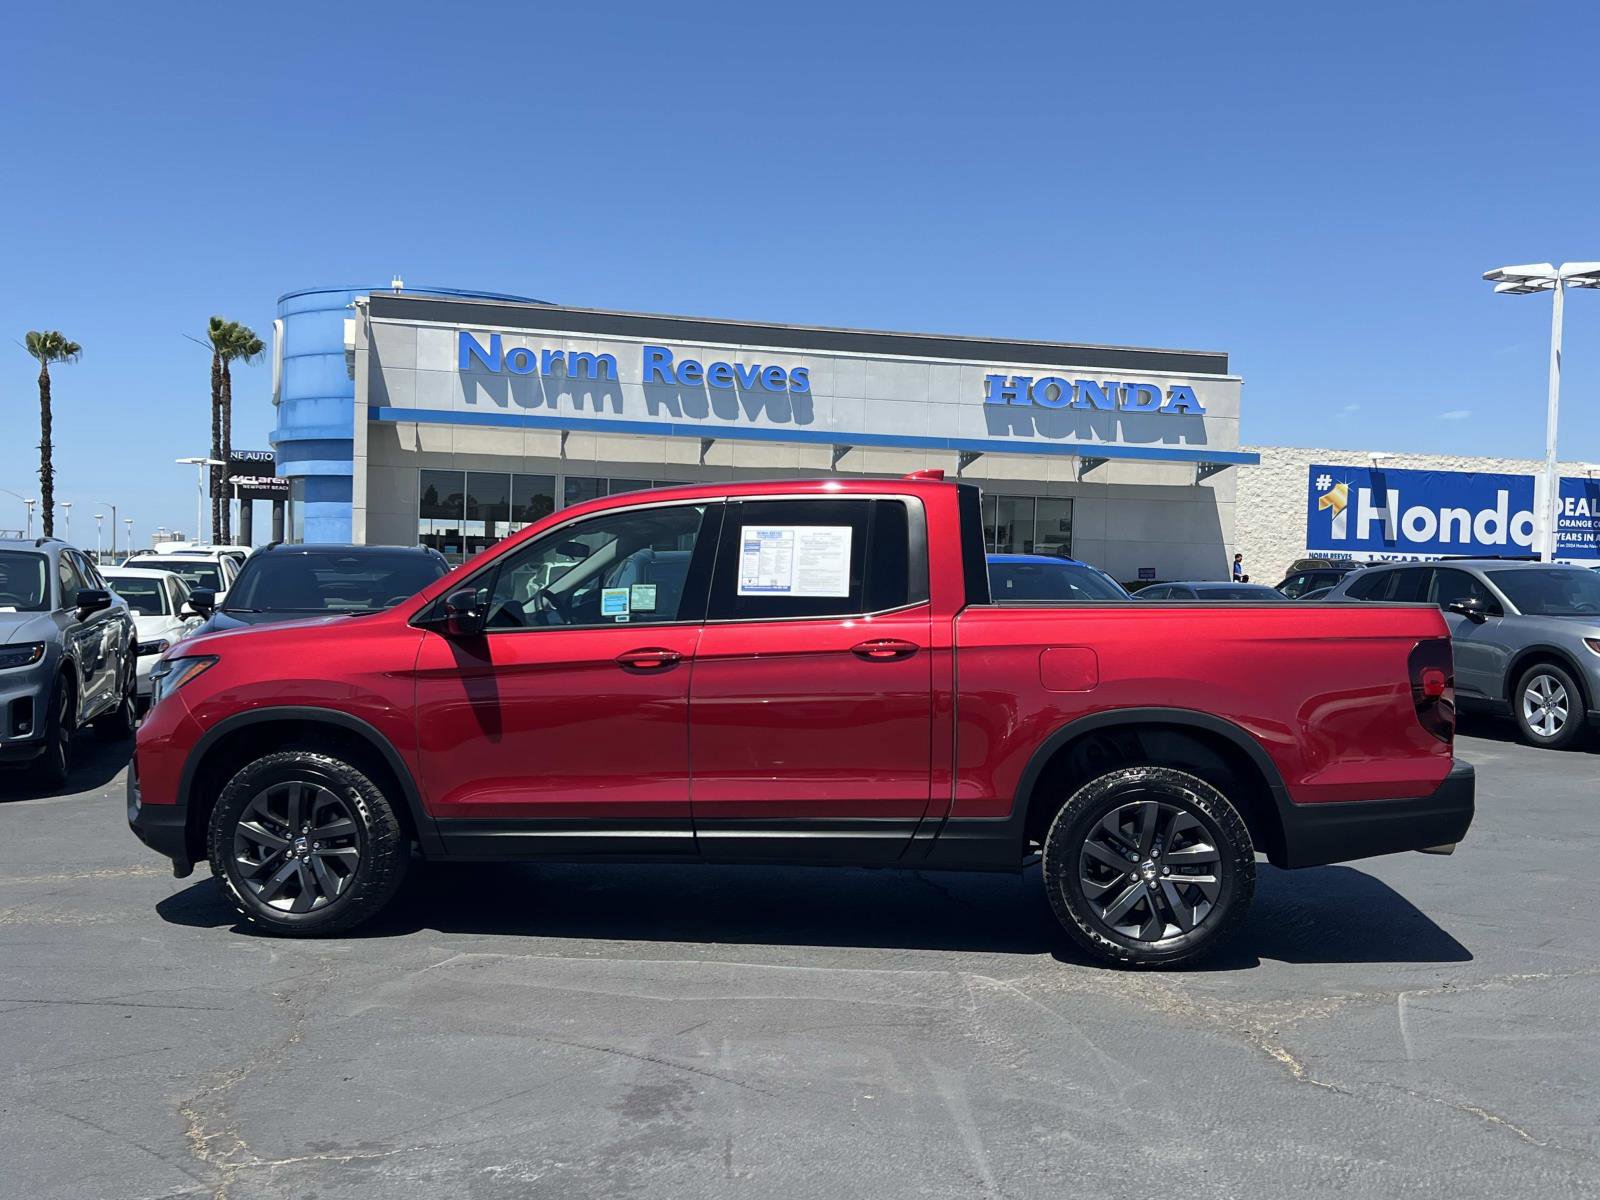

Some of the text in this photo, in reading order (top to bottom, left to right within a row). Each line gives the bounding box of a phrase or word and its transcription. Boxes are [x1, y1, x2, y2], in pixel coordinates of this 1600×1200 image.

[458, 331, 811, 393] Norm Reeves
[985, 374, 1206, 414] HONDA
[246, 452, 274, 461] AUTO
[1559, 519, 1592, 528] ORANGE
[1583, 533, 1594, 542] IN
[1330, 552, 1352, 560] REEVES
